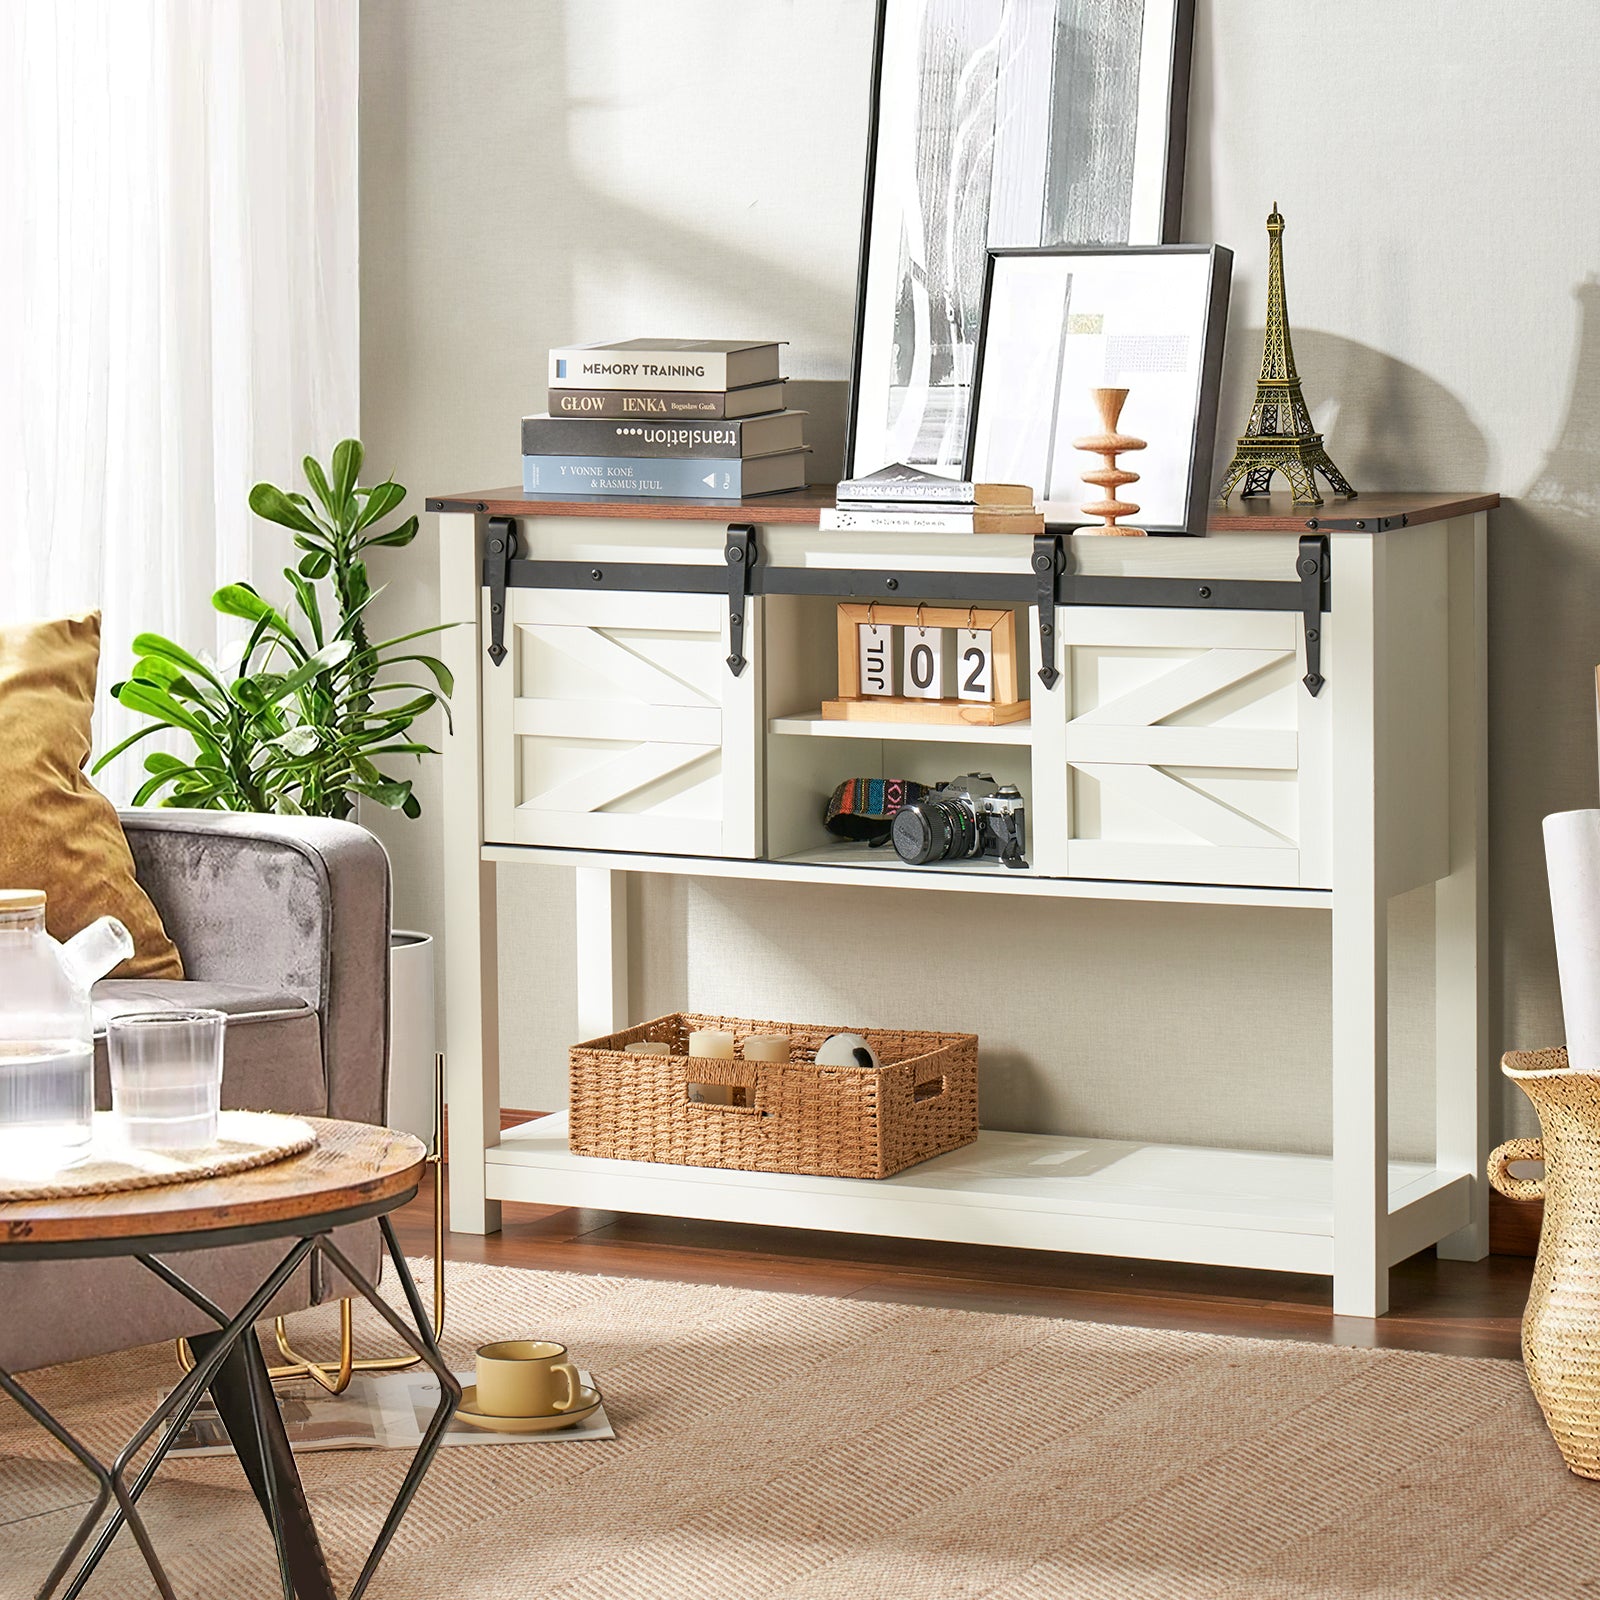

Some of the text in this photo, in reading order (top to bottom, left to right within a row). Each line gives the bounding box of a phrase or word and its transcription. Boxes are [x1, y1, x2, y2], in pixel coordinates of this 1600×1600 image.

[583, 363, 705, 377] MEMORY TRAINING
[623, 398, 667, 412] IENKA
[570, 466, 604, 476] VONNE
[590, 479, 663, 490] & RASMUS JUUL
[867, 640, 885, 690] JUL
[910, 643, 986, 693] 0 2
